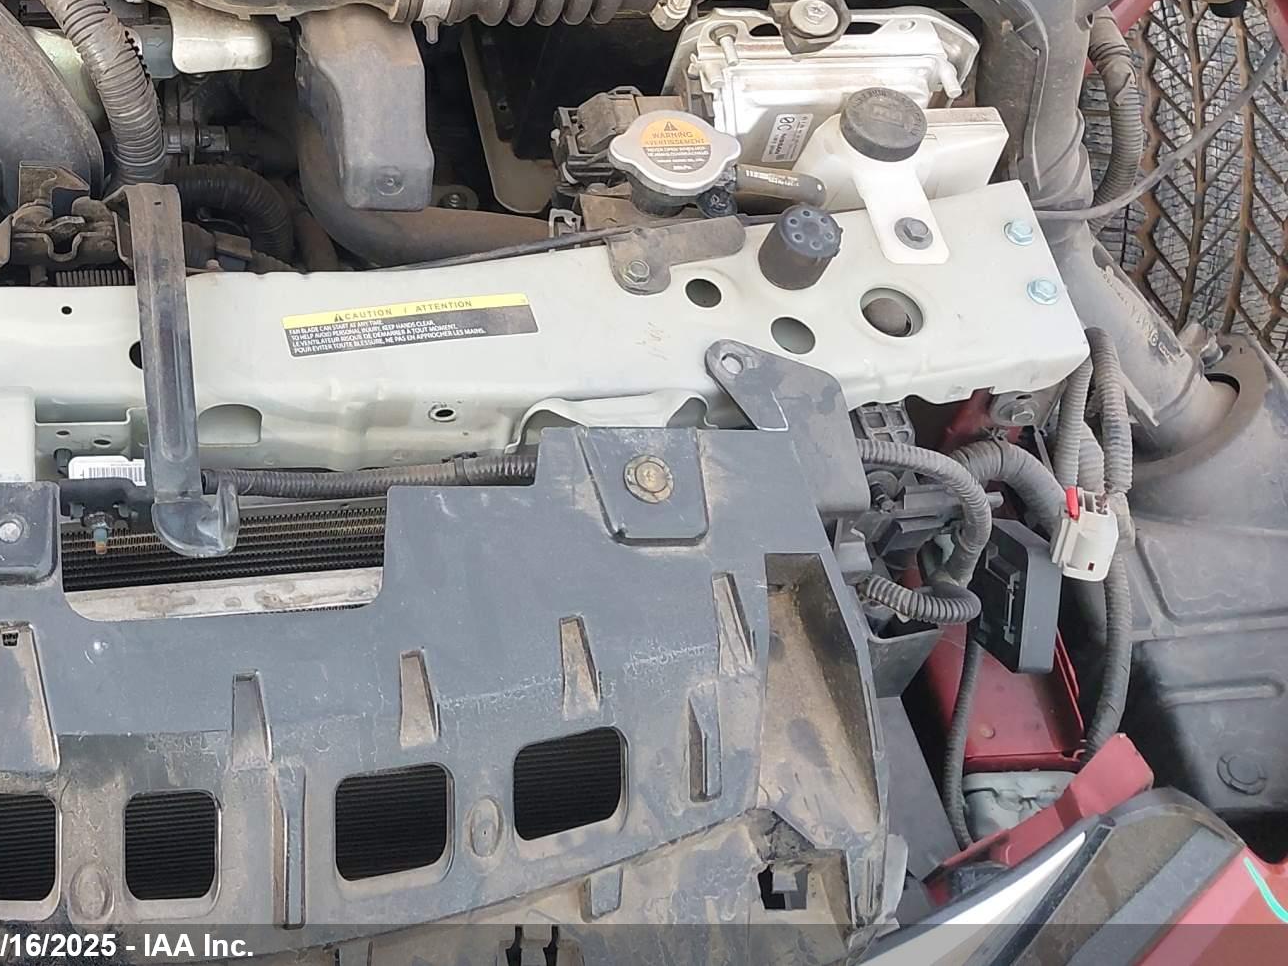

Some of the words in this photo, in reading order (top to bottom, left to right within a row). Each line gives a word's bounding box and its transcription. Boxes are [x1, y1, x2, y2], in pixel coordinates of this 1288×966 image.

[652, 131, 693, 139] WARNING
[645, 138, 705, 146] AVERTISSEMENT
[344, 308, 392, 320] CAUTION
[415, 300, 472, 313] ATTENTION
[332, 328, 361, 336] PERSONAL
[294, 346, 312, 354] POUR
[416, 330, 453, 339] APPROCHER
[300, 337, 341, 346] VENTILATEUR
